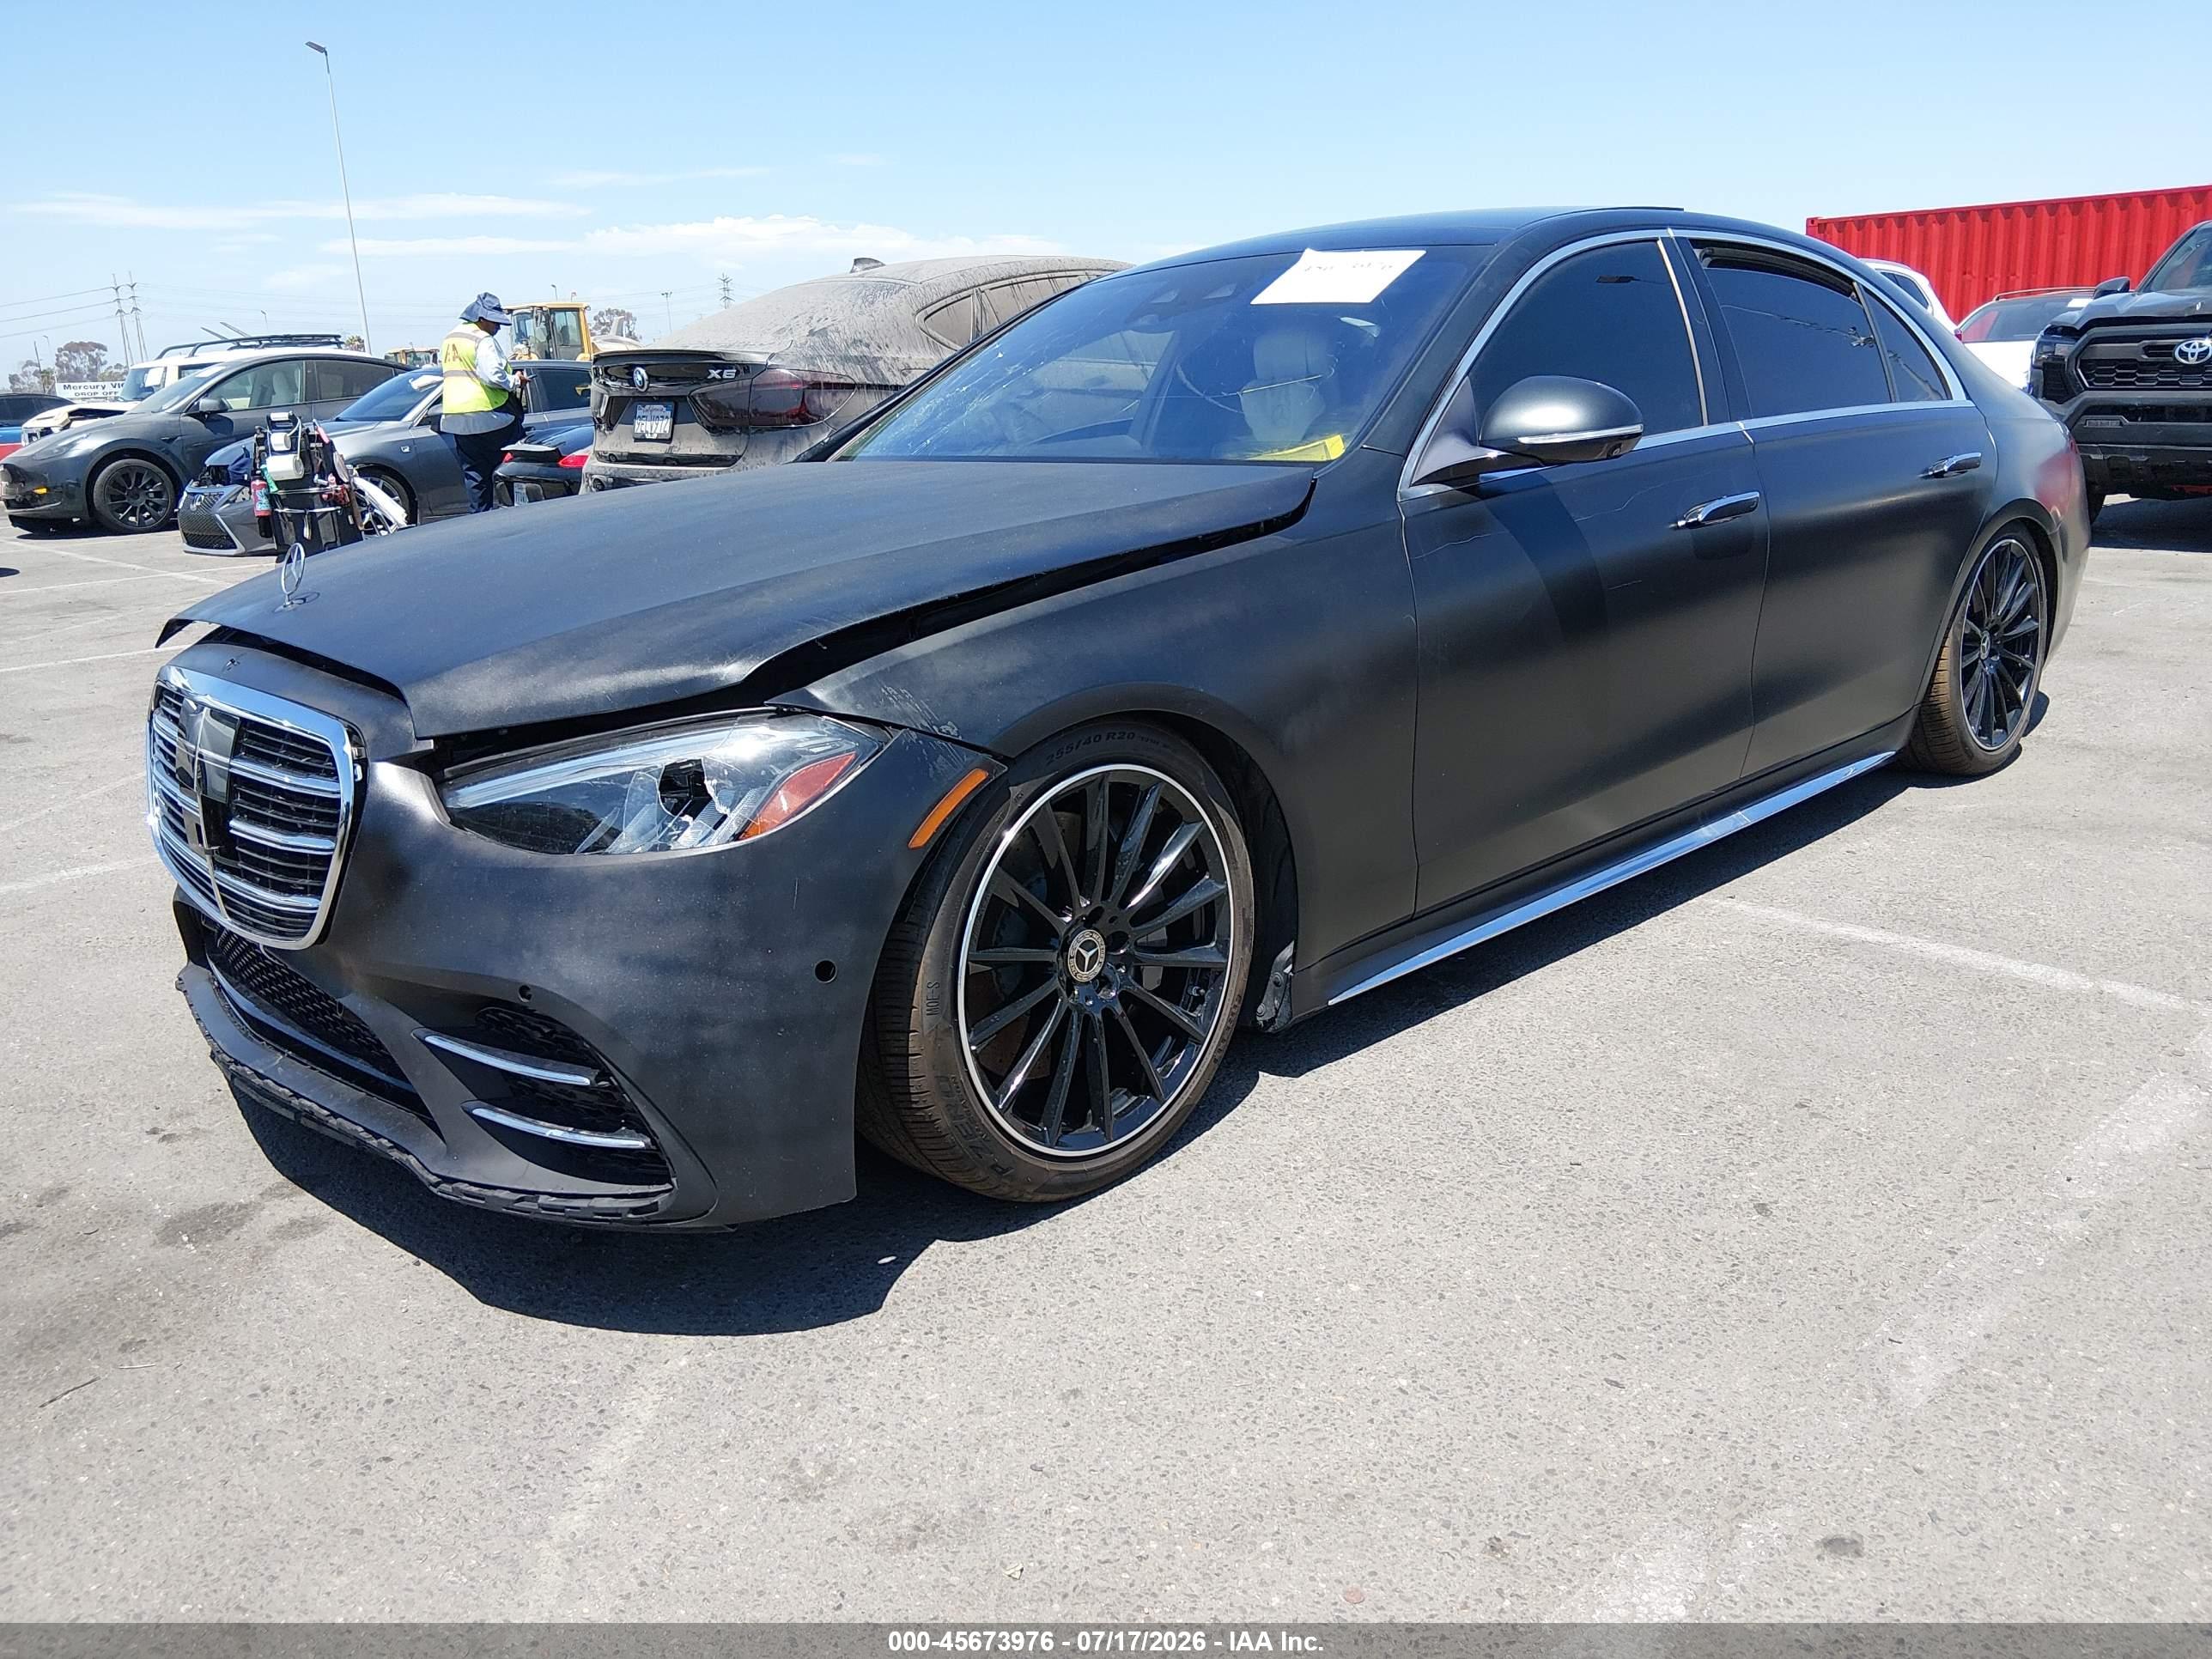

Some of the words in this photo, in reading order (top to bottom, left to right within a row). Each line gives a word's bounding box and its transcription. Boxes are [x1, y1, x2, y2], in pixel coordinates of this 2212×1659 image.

[707, 369, 737, 379] X6
[1045, 734, 1102, 766] 255/40
[1105, 731, 1135, 742] R20
